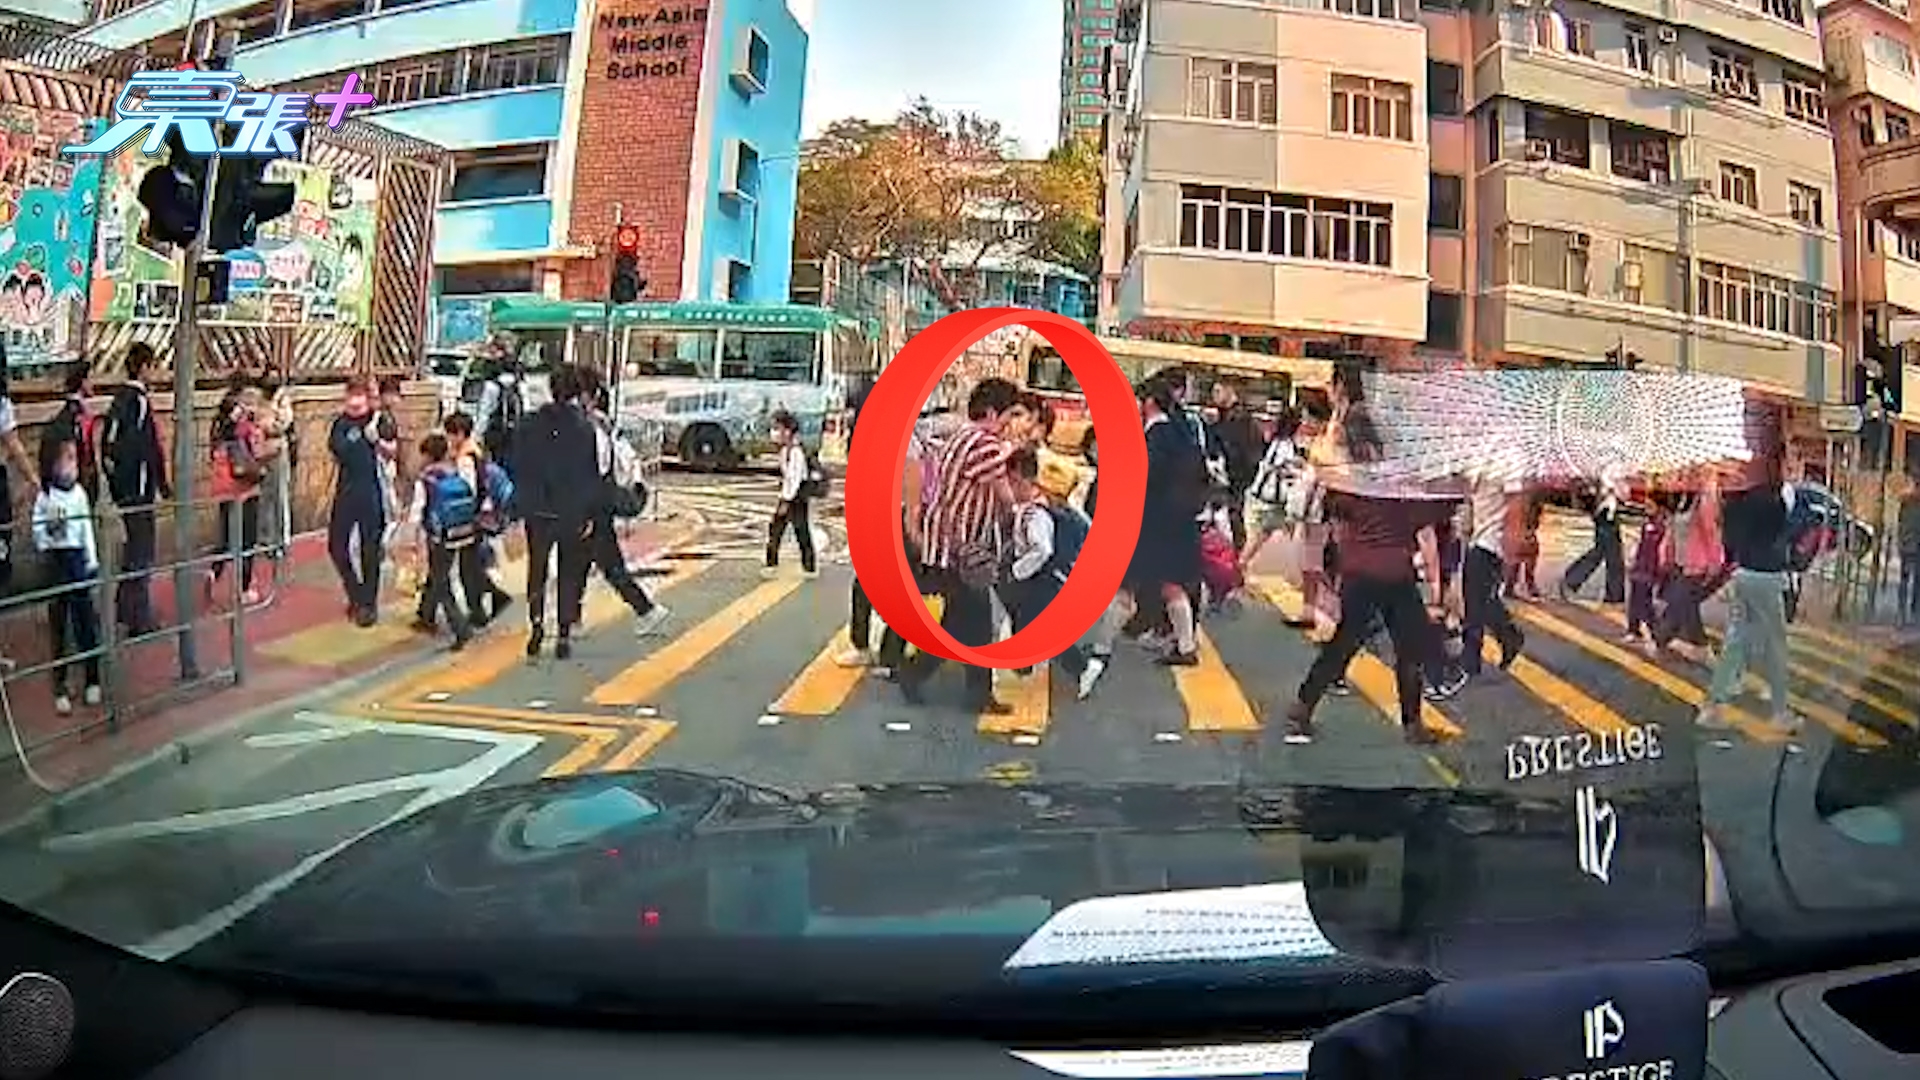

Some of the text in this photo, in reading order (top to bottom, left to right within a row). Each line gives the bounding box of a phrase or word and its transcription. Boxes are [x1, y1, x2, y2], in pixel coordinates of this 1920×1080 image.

[600, 4, 708, 28] New Asia
[611, 33, 687, 53] Middle
[606, 57, 686, 79] School
